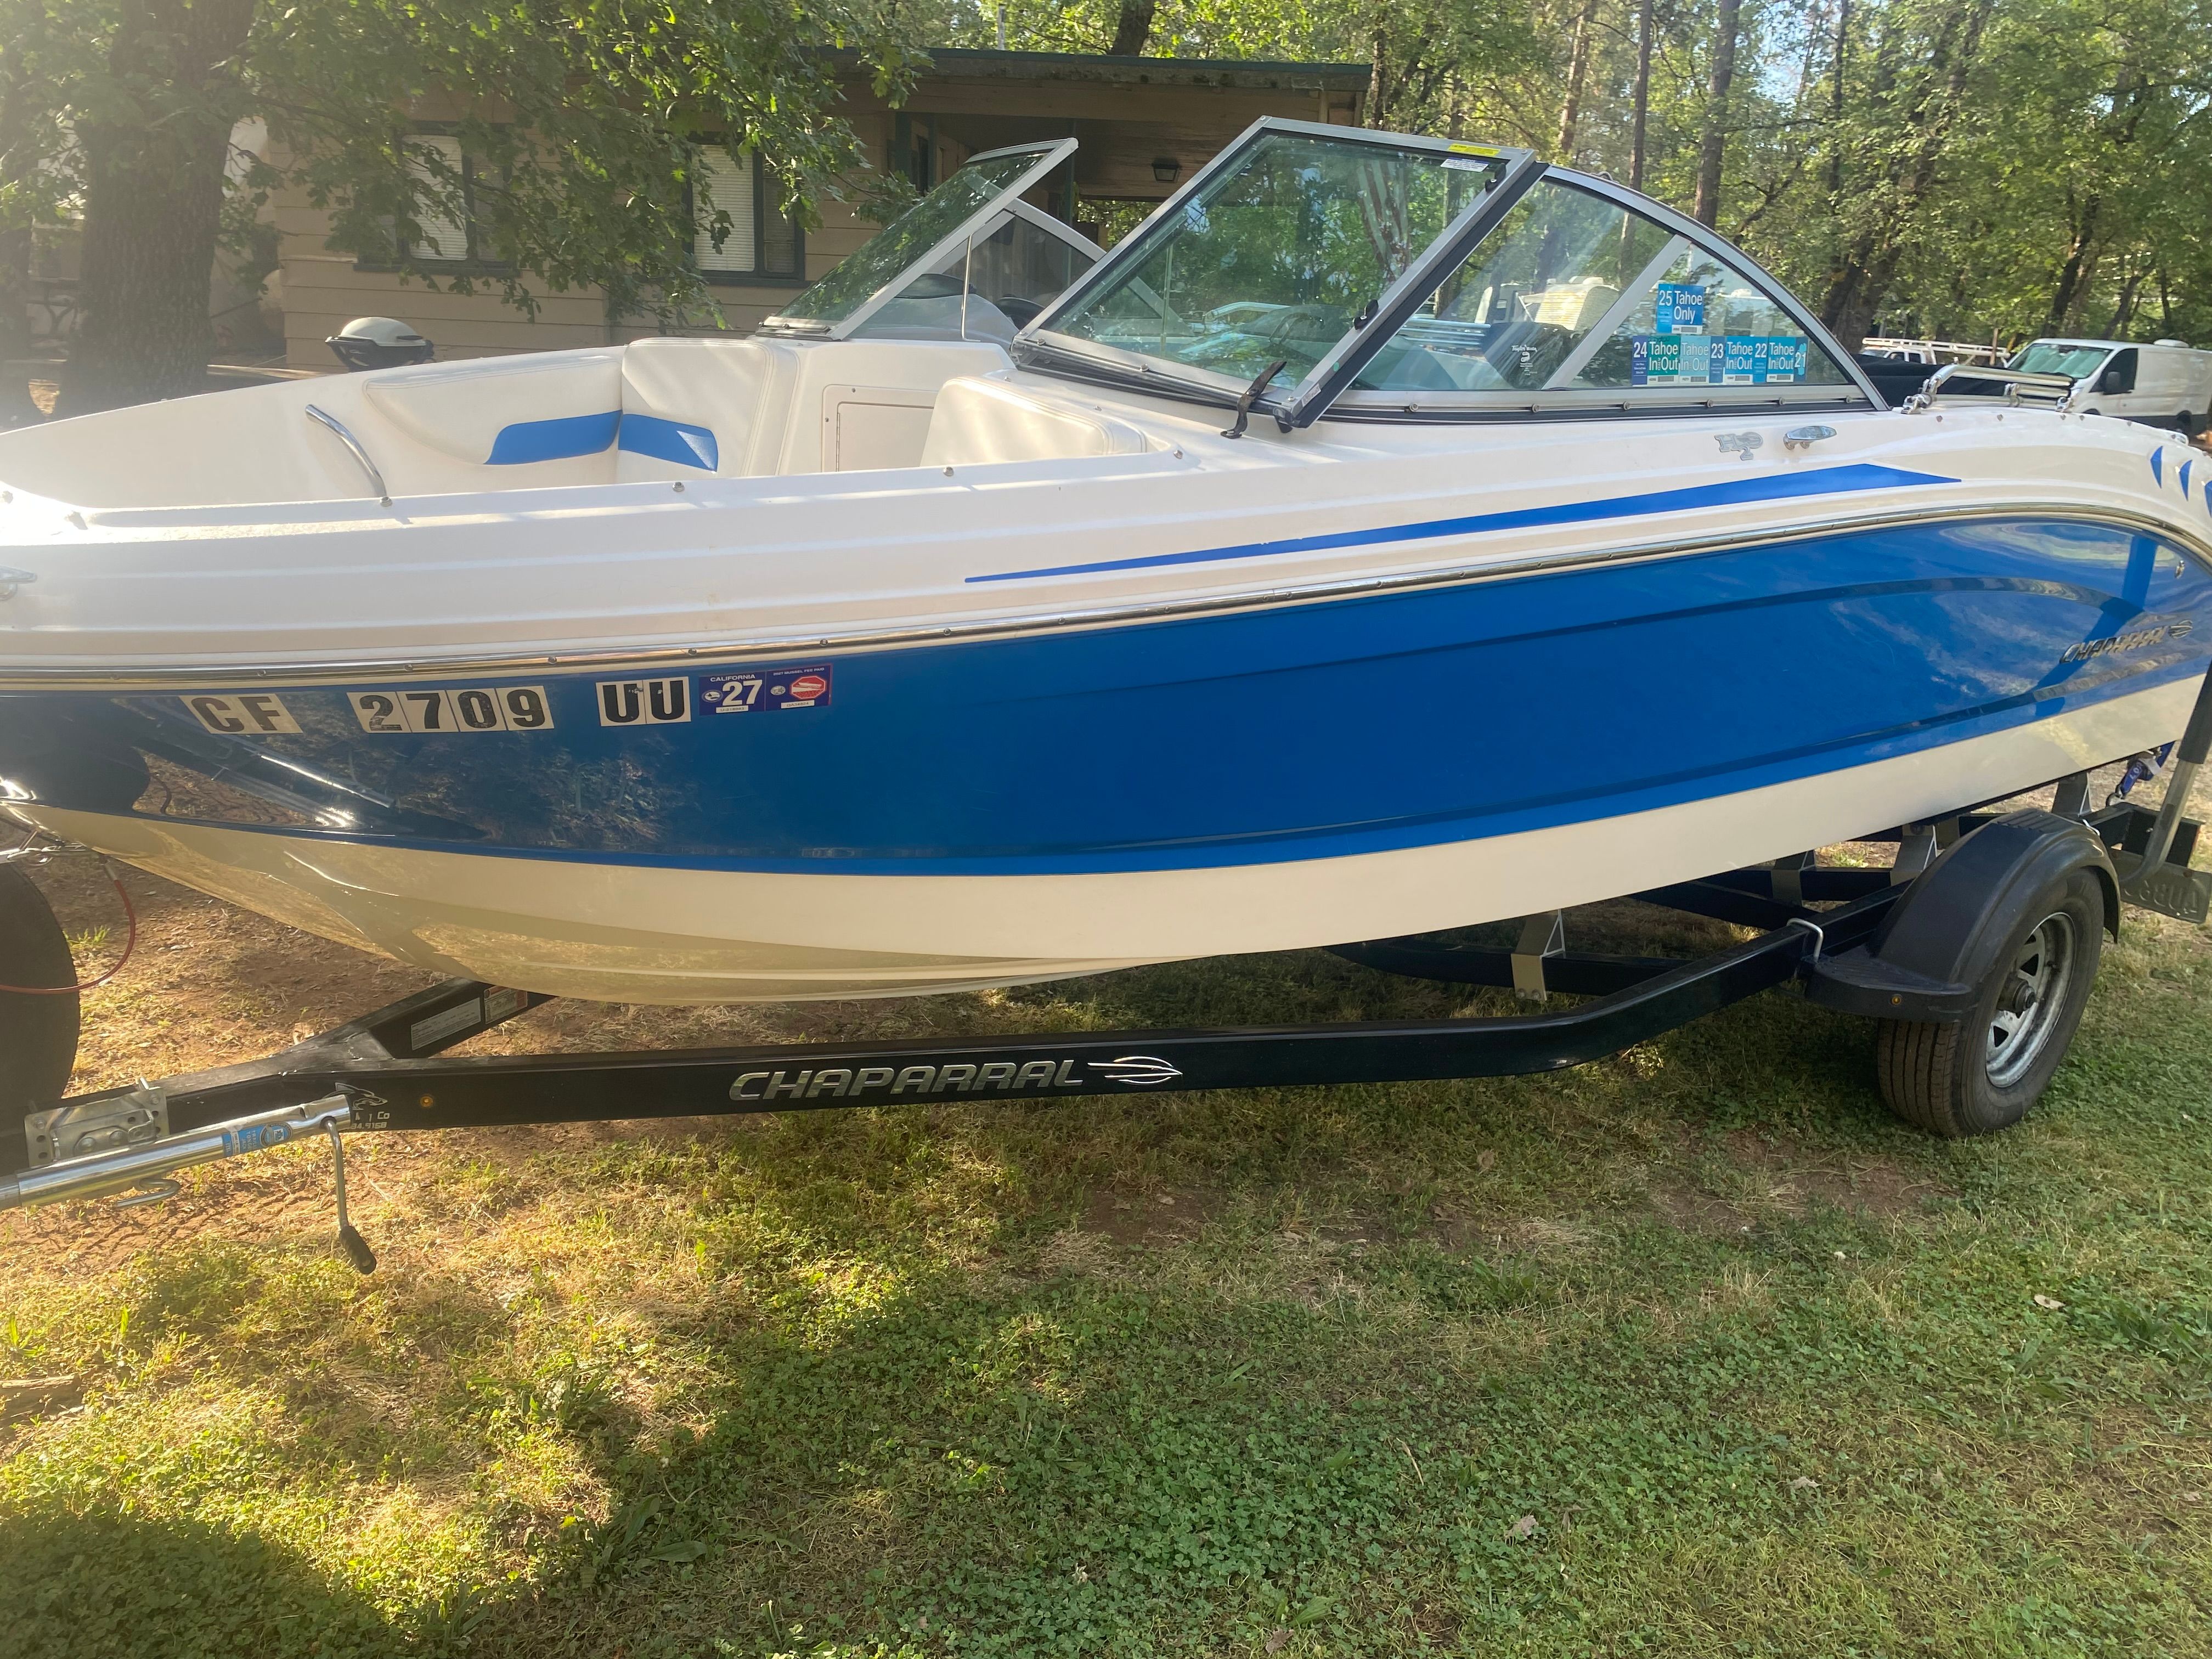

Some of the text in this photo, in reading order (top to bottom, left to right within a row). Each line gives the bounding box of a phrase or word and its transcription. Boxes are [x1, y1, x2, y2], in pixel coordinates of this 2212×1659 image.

[1658, 290, 1703, 306] 25 Tahoe
[1674, 306, 1696, 324] Only
[1633, 341, 1647, 358] 24
[1649, 341, 1678, 356] Tahoe
[1681, 342, 1709, 356] Tahoe
[1711, 343, 1724, 359] 23
[1726, 341, 1753, 355] Tahoe
[1754, 343, 1767, 358] 22
[1769, 342, 1795, 356] Tahoe
[1795, 352, 1807, 368] 21
[710, 674, 755, 682] CALIFORNIA
[722, 680, 763, 706] 27
[190, 680, 685, 732] CF 2709 UU
[730, 1059, 1084, 1101] CHAPARRAL
[377, 1111, 390, 1120] Co
